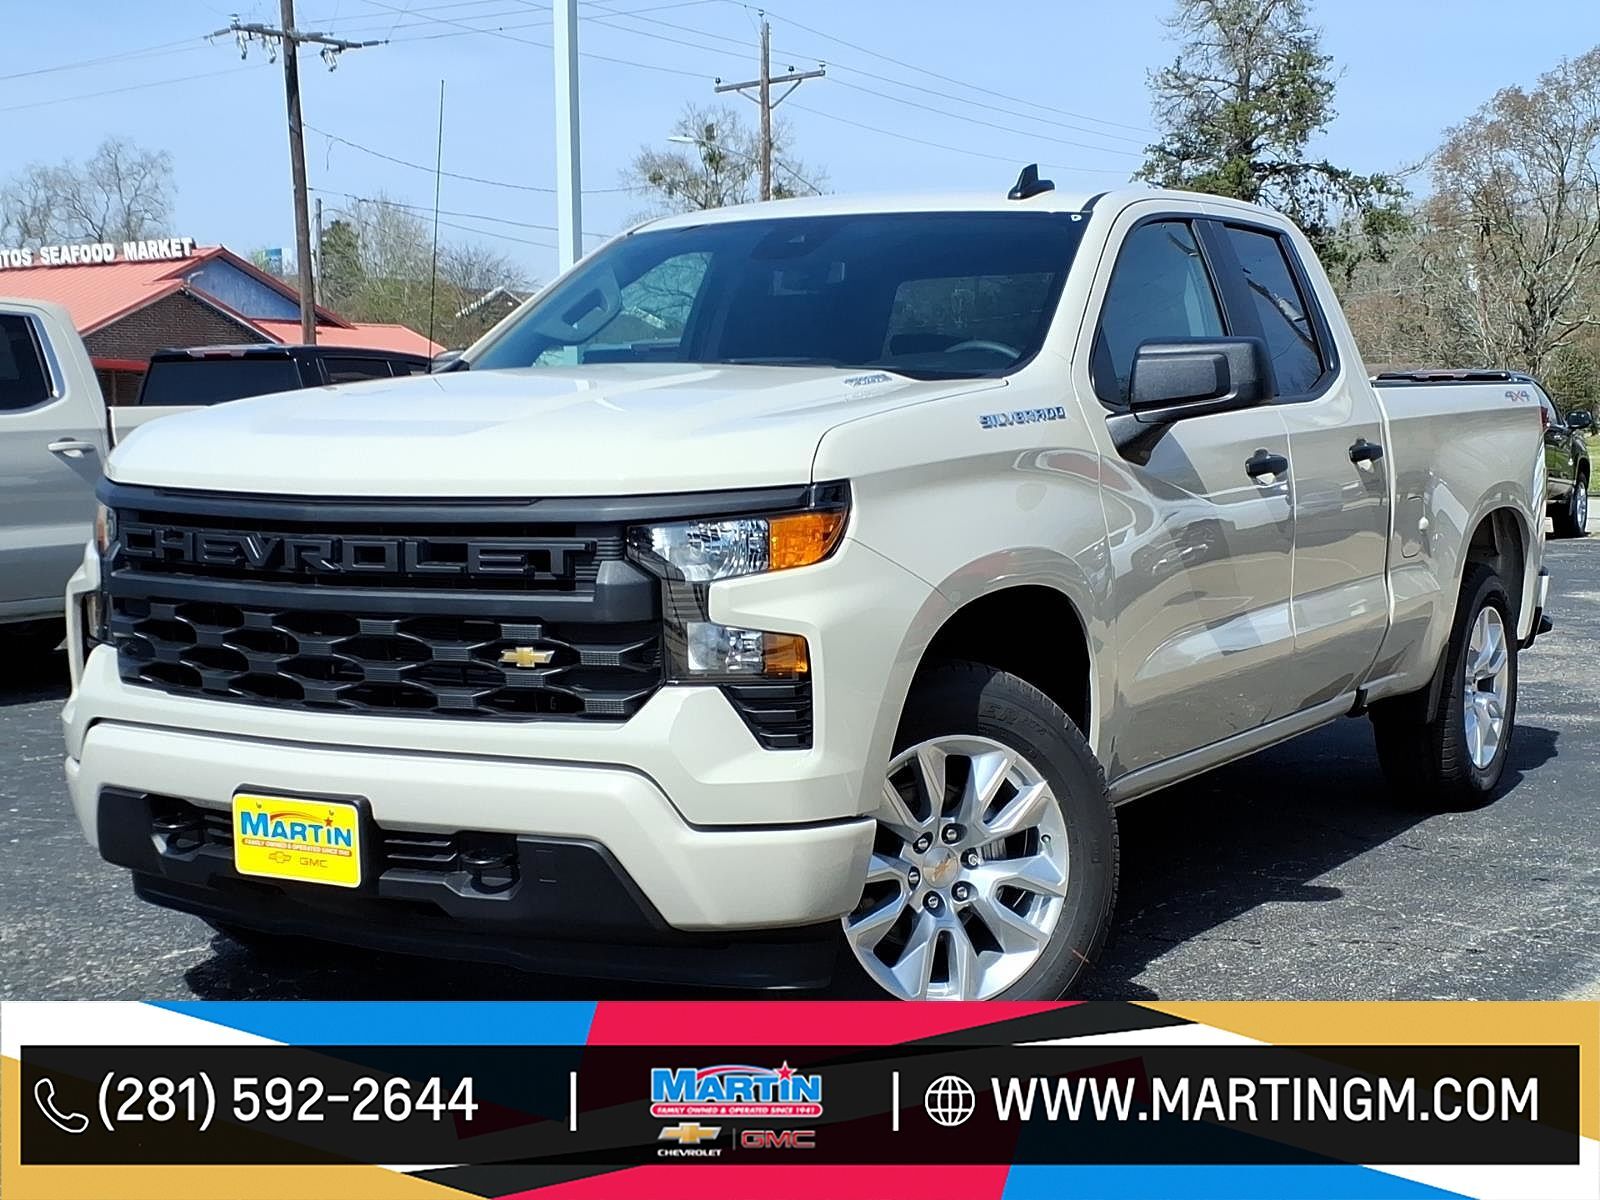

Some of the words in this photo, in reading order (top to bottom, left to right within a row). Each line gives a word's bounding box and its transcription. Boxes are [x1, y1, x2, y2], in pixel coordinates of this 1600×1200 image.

[0, 247, 33, 268] TOS
[40, 243, 116, 266] SEAFOOD
[123, 237, 195, 261] MARKET
[980, 406, 1066, 429] SILVERADO
[119, 525, 597, 580] CHEVROLET
[299, 857, 329, 868] GMC
